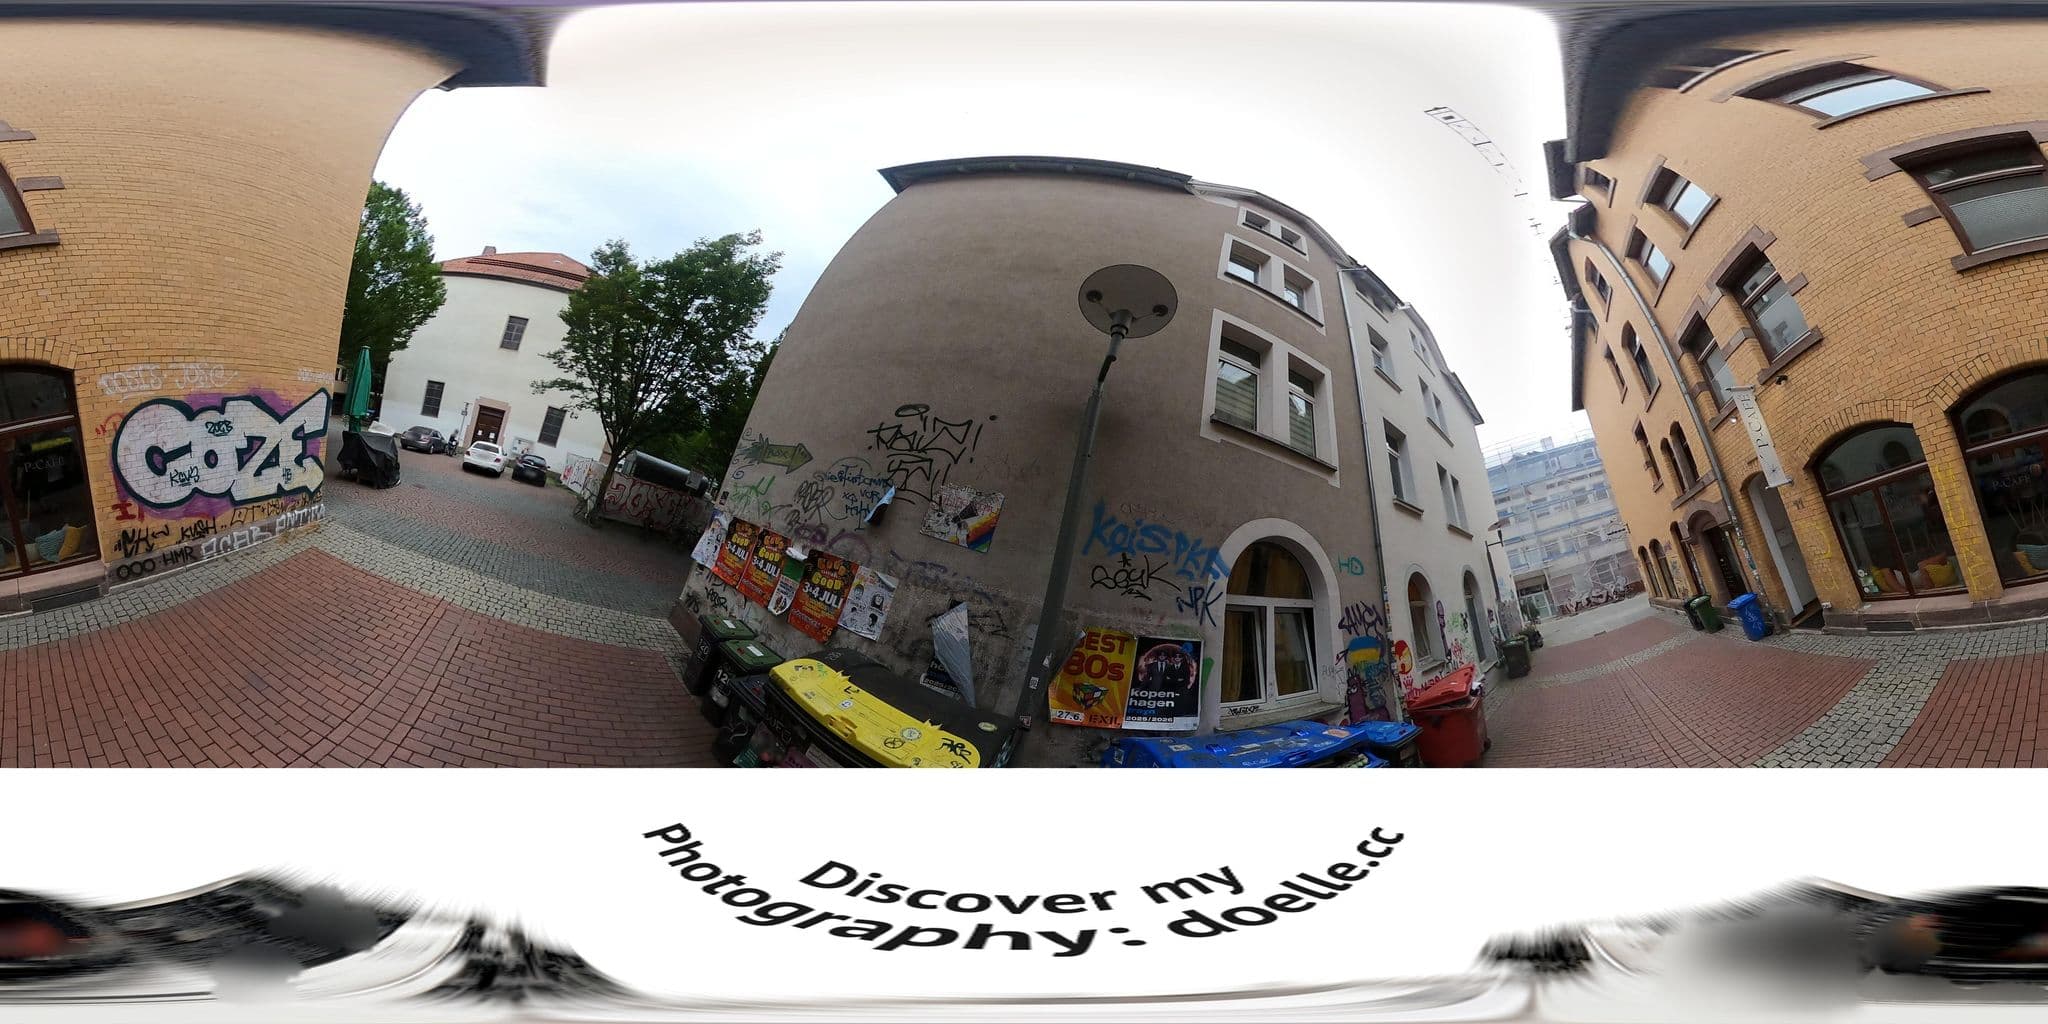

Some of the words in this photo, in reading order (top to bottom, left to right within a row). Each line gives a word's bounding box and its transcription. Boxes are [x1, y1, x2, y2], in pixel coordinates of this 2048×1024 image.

[763, 562, 781, 578] JULI
[819, 590, 844, 609] JULI
[1130, 688, 1180, 699] kopen-
[1129, 697, 1175, 709] hagen
[1056, 710, 1082, 721] 27.6.
[1125, 715, 1174, 723] 2025/2026
